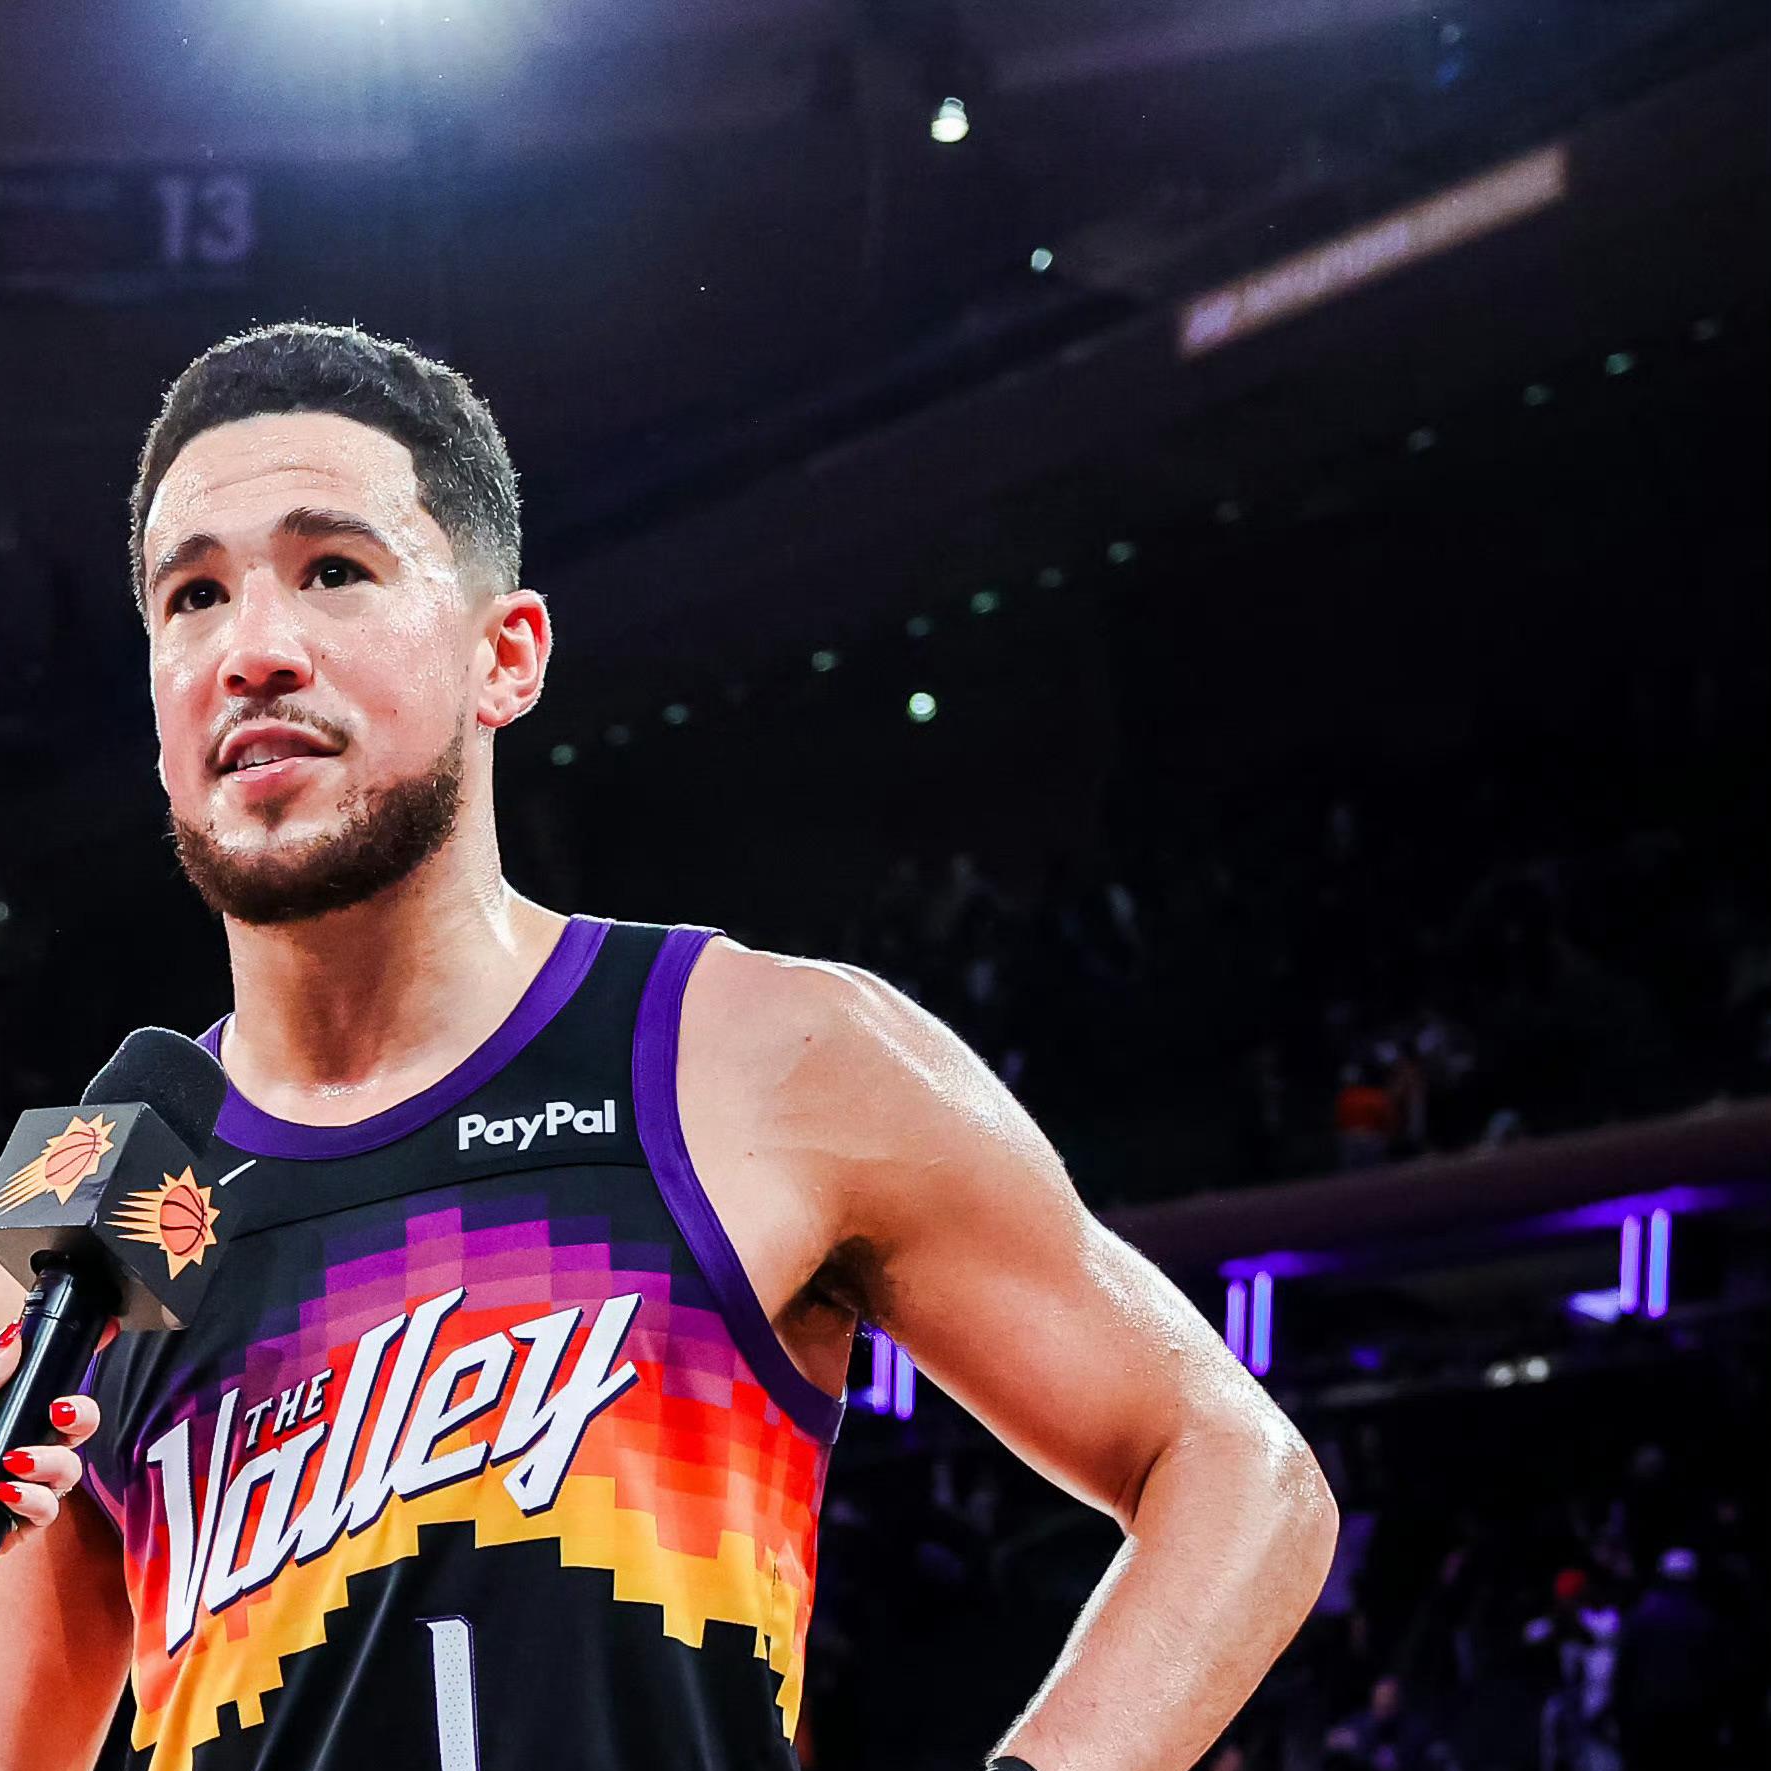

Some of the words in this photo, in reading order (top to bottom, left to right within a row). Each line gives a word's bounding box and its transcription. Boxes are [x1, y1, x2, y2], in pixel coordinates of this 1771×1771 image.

[157, 177, 256, 265] 13
[458, 1099, 617, 1151] PayPal
[244, 1368, 334, 1449] THE
[147, 1285, 645, 1658] Valley
